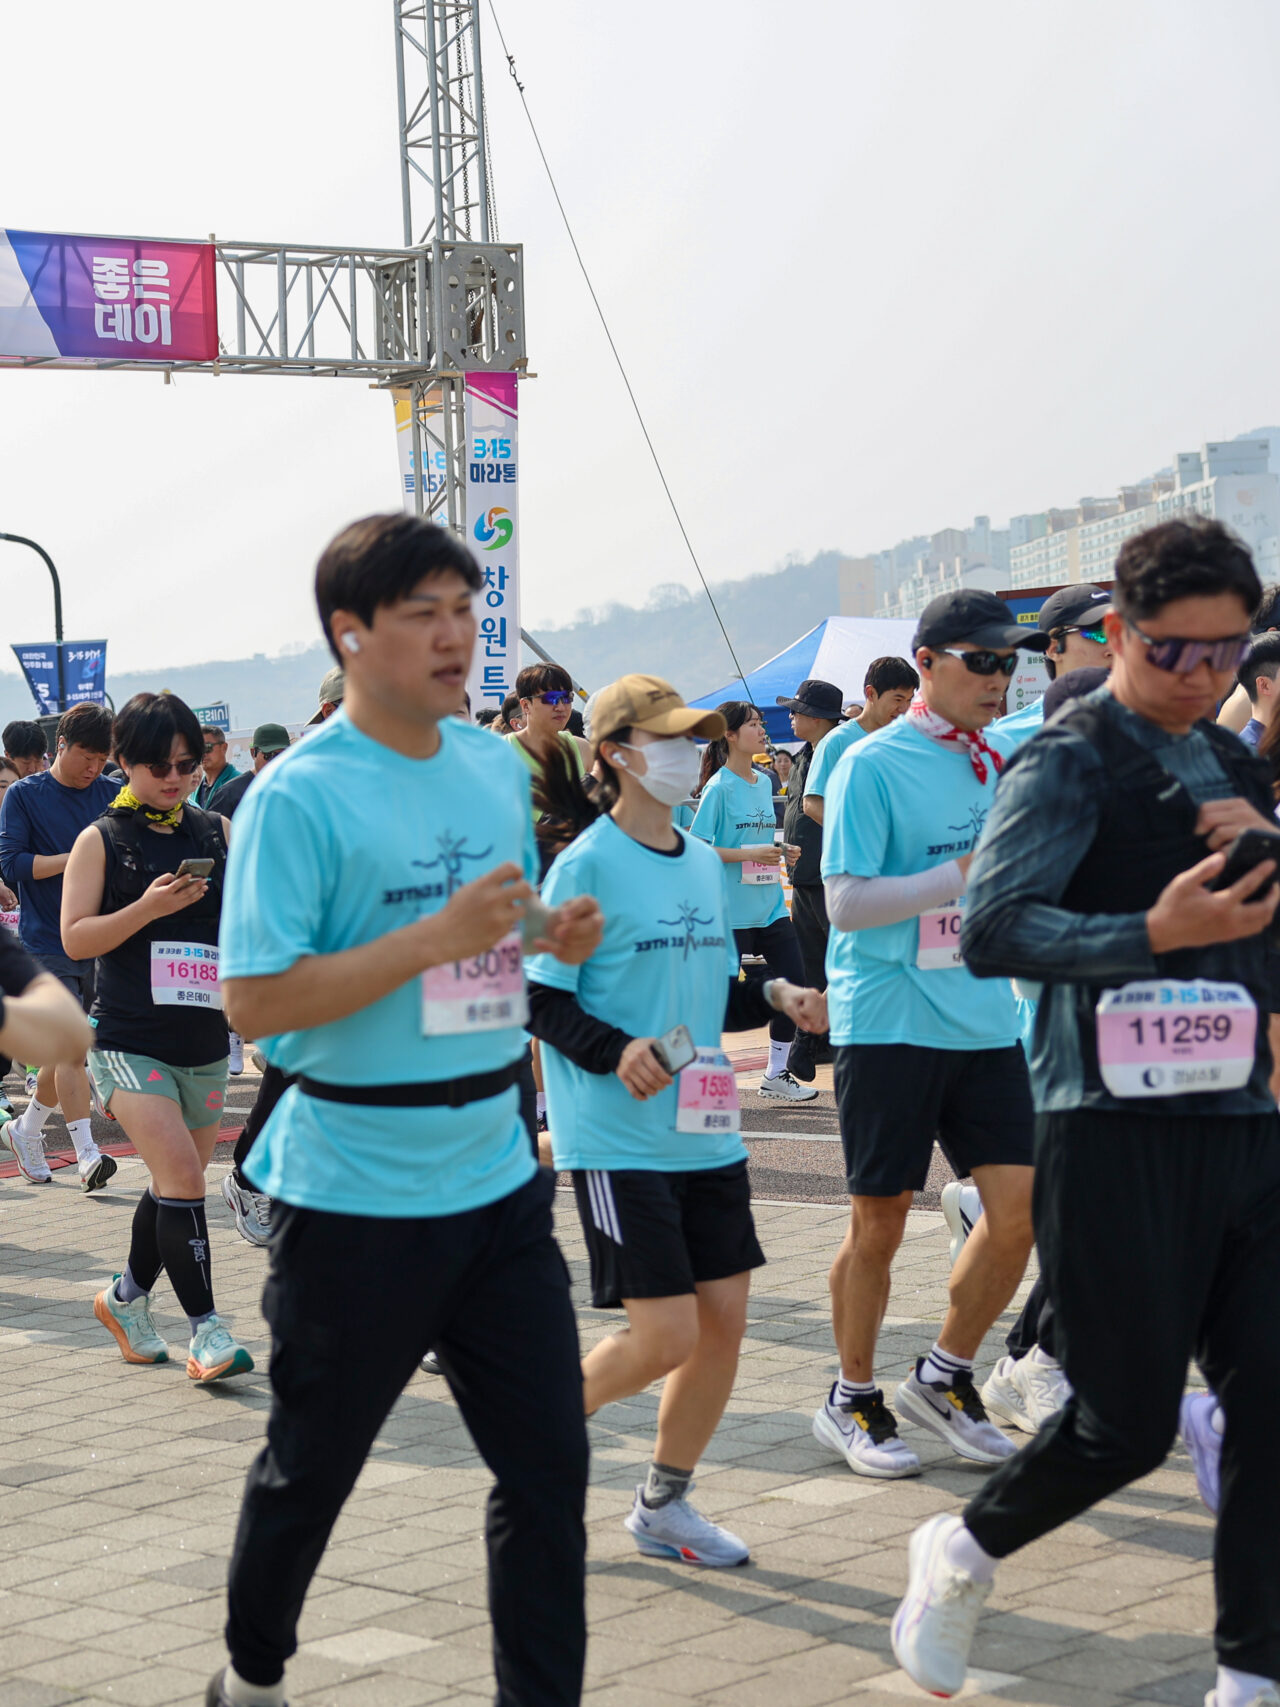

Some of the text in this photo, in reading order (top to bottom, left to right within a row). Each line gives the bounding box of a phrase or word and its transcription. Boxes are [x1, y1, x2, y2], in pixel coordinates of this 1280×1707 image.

[92, 256, 170, 301] 좋은
[94, 303, 172, 345] 데이
[470, 463, 516, 483] 마라톤
[167, 962, 218, 982] 16183
[177, 990, 210, 1003] 좋은데이
[1129, 1014, 1232, 1045] 11259
